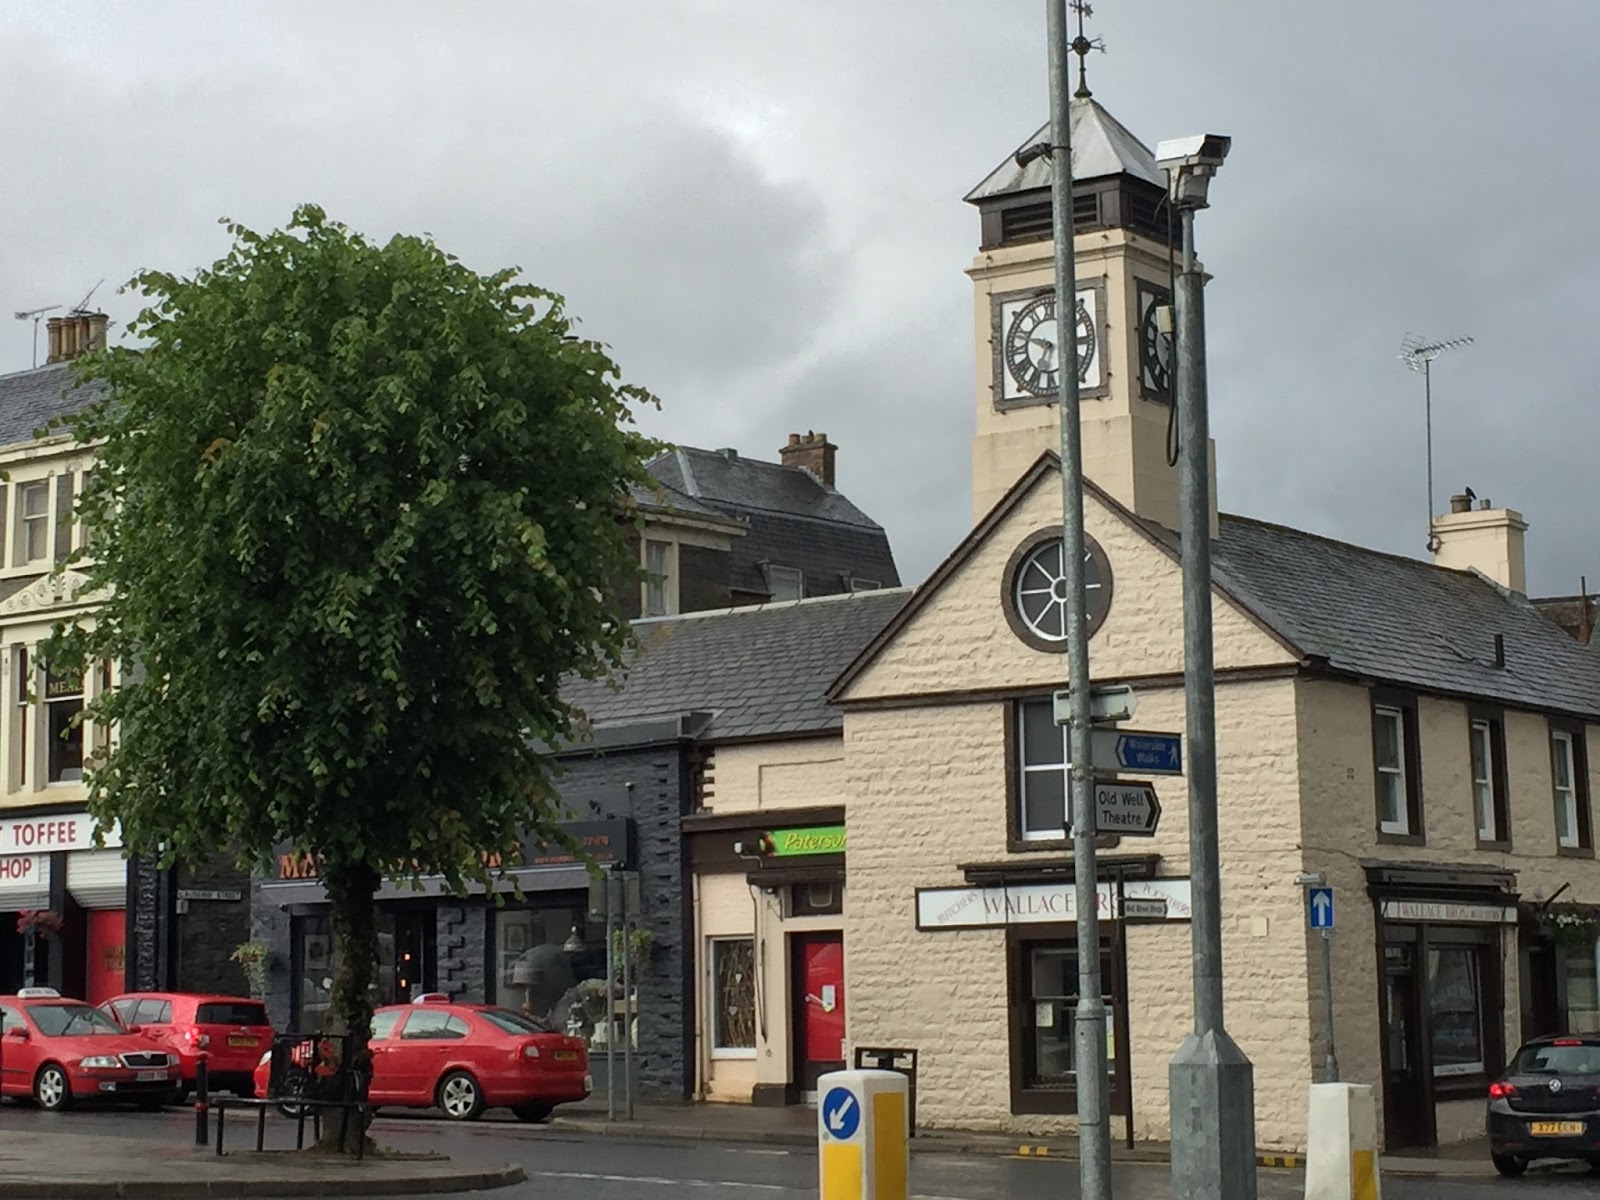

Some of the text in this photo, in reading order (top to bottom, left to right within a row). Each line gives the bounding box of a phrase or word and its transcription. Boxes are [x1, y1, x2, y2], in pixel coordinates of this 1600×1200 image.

[1099, 791, 1117, 805] Old
[1121, 792, 1144, 806] Well
[1102, 810, 1142, 824] Theatre
[13, 821, 76, 846] TOFFEE
[983, 893, 1074, 915] WALLACE
